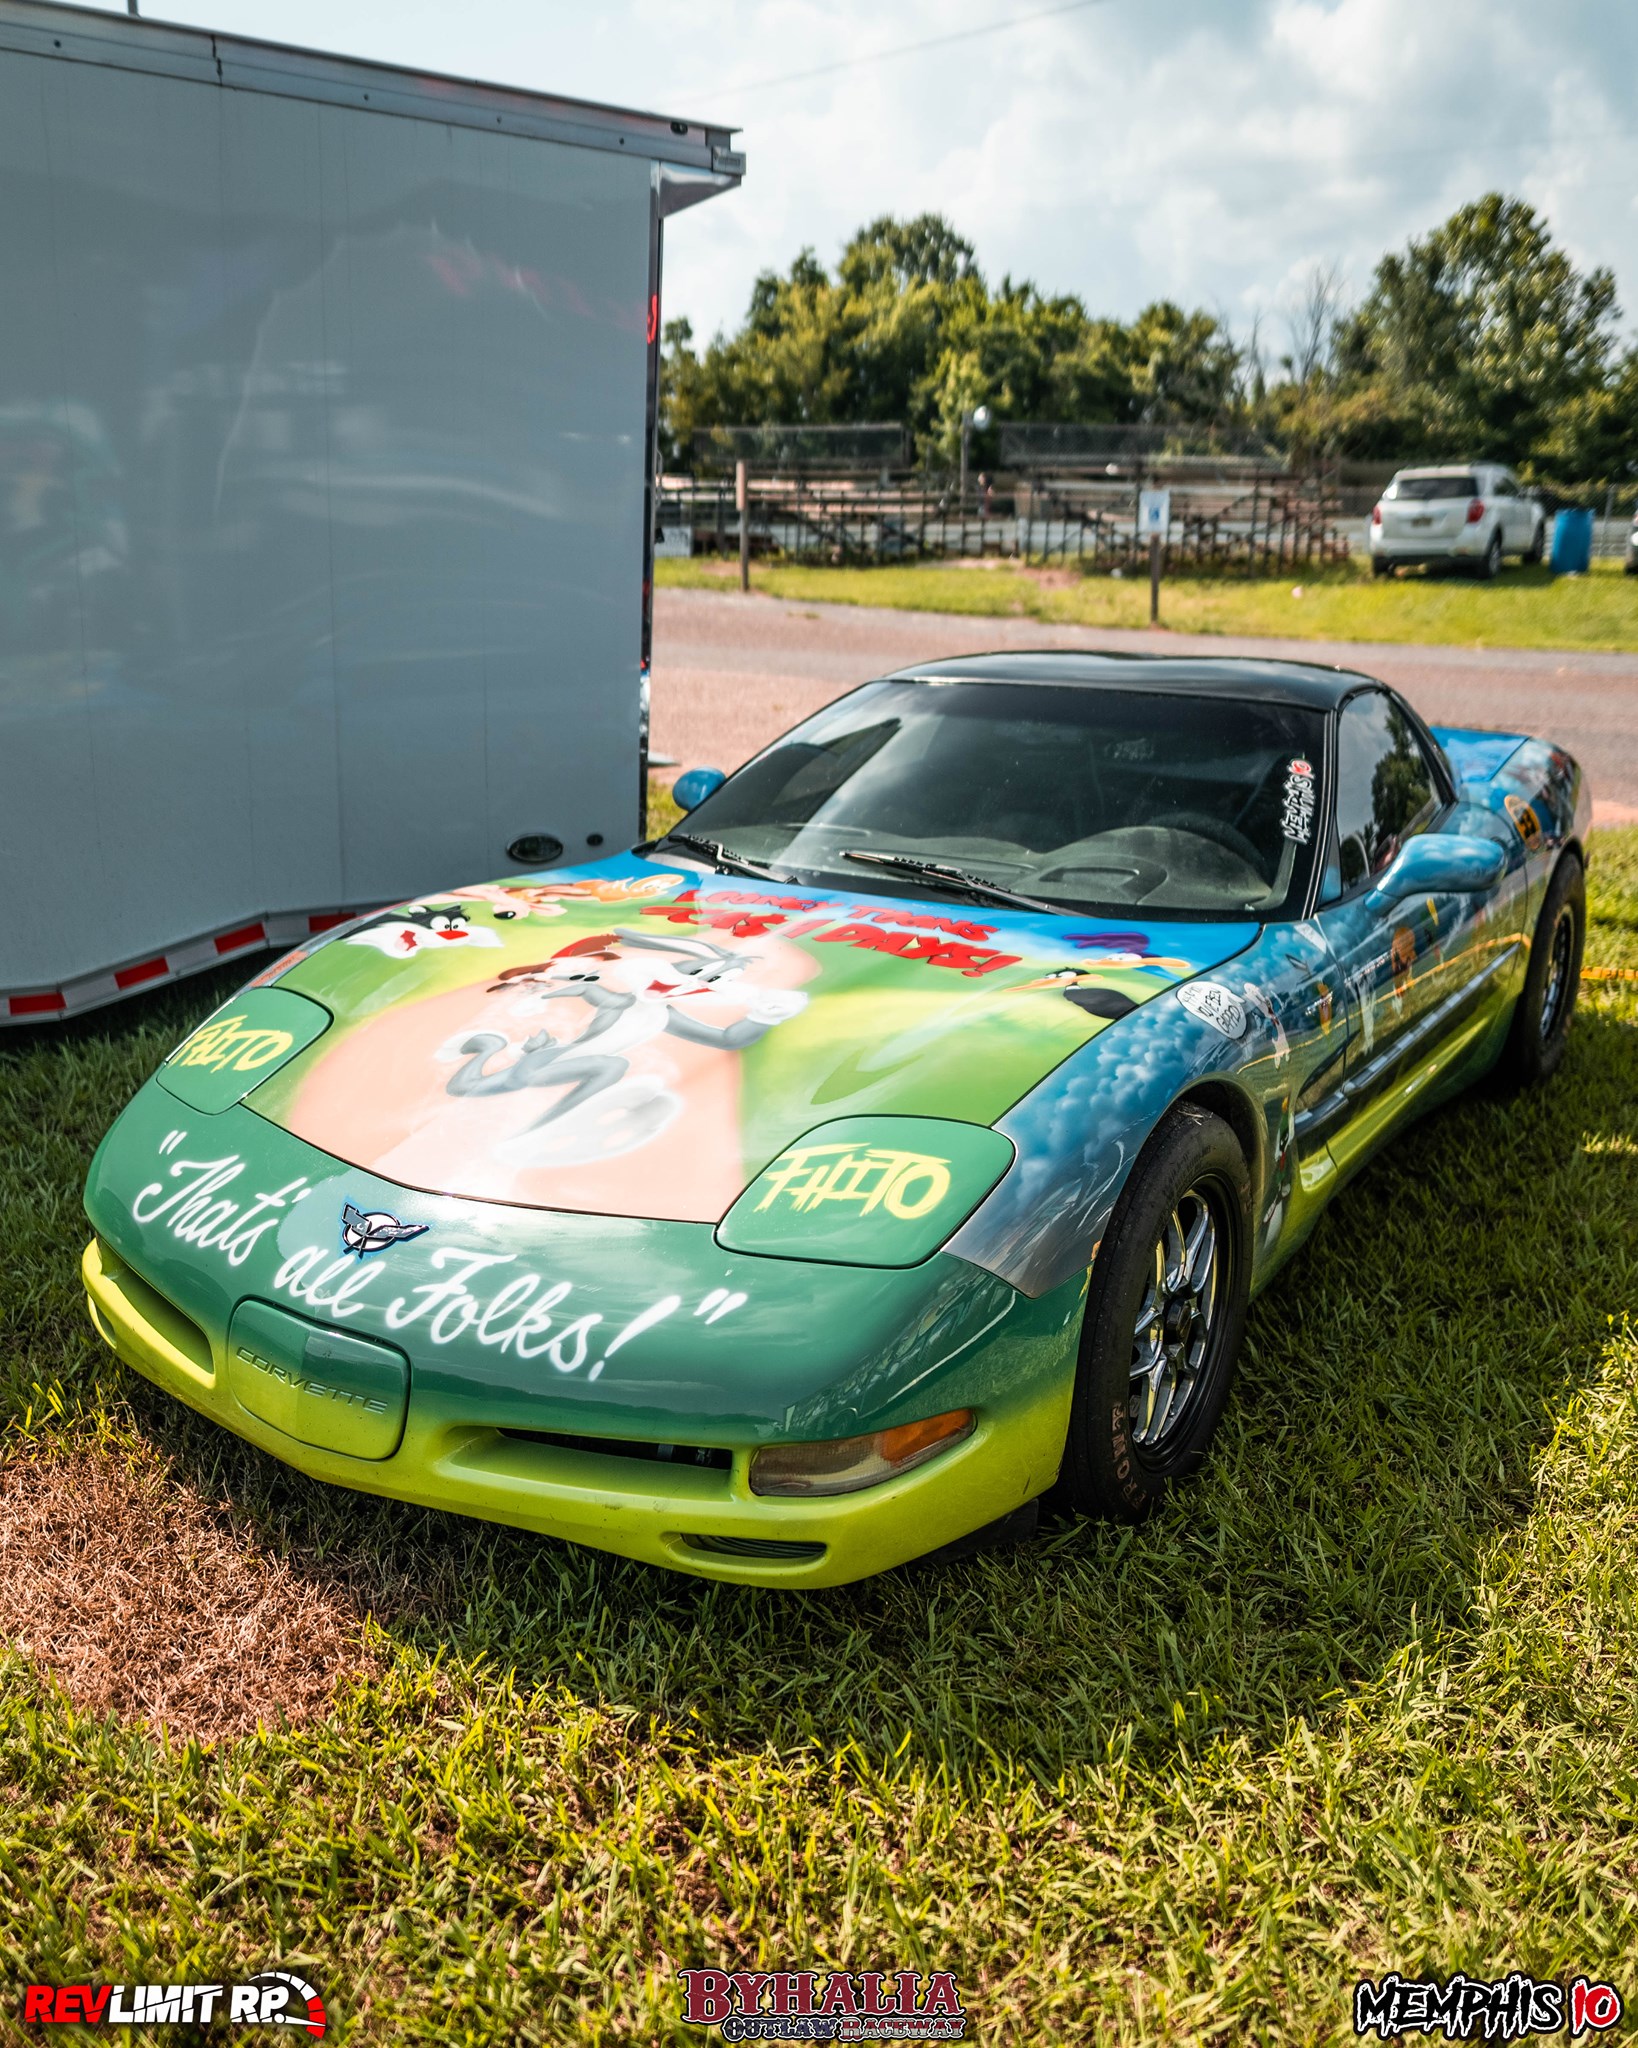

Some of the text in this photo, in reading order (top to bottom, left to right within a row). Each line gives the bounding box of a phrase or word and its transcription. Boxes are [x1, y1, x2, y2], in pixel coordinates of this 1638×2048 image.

[672, 889, 1002, 941] LOONEY TOONS
[811, 922, 1024, 979] DAYS!
[273, 1245, 386, 1318] all
[236, 1346, 388, 1415] CORVETTE
